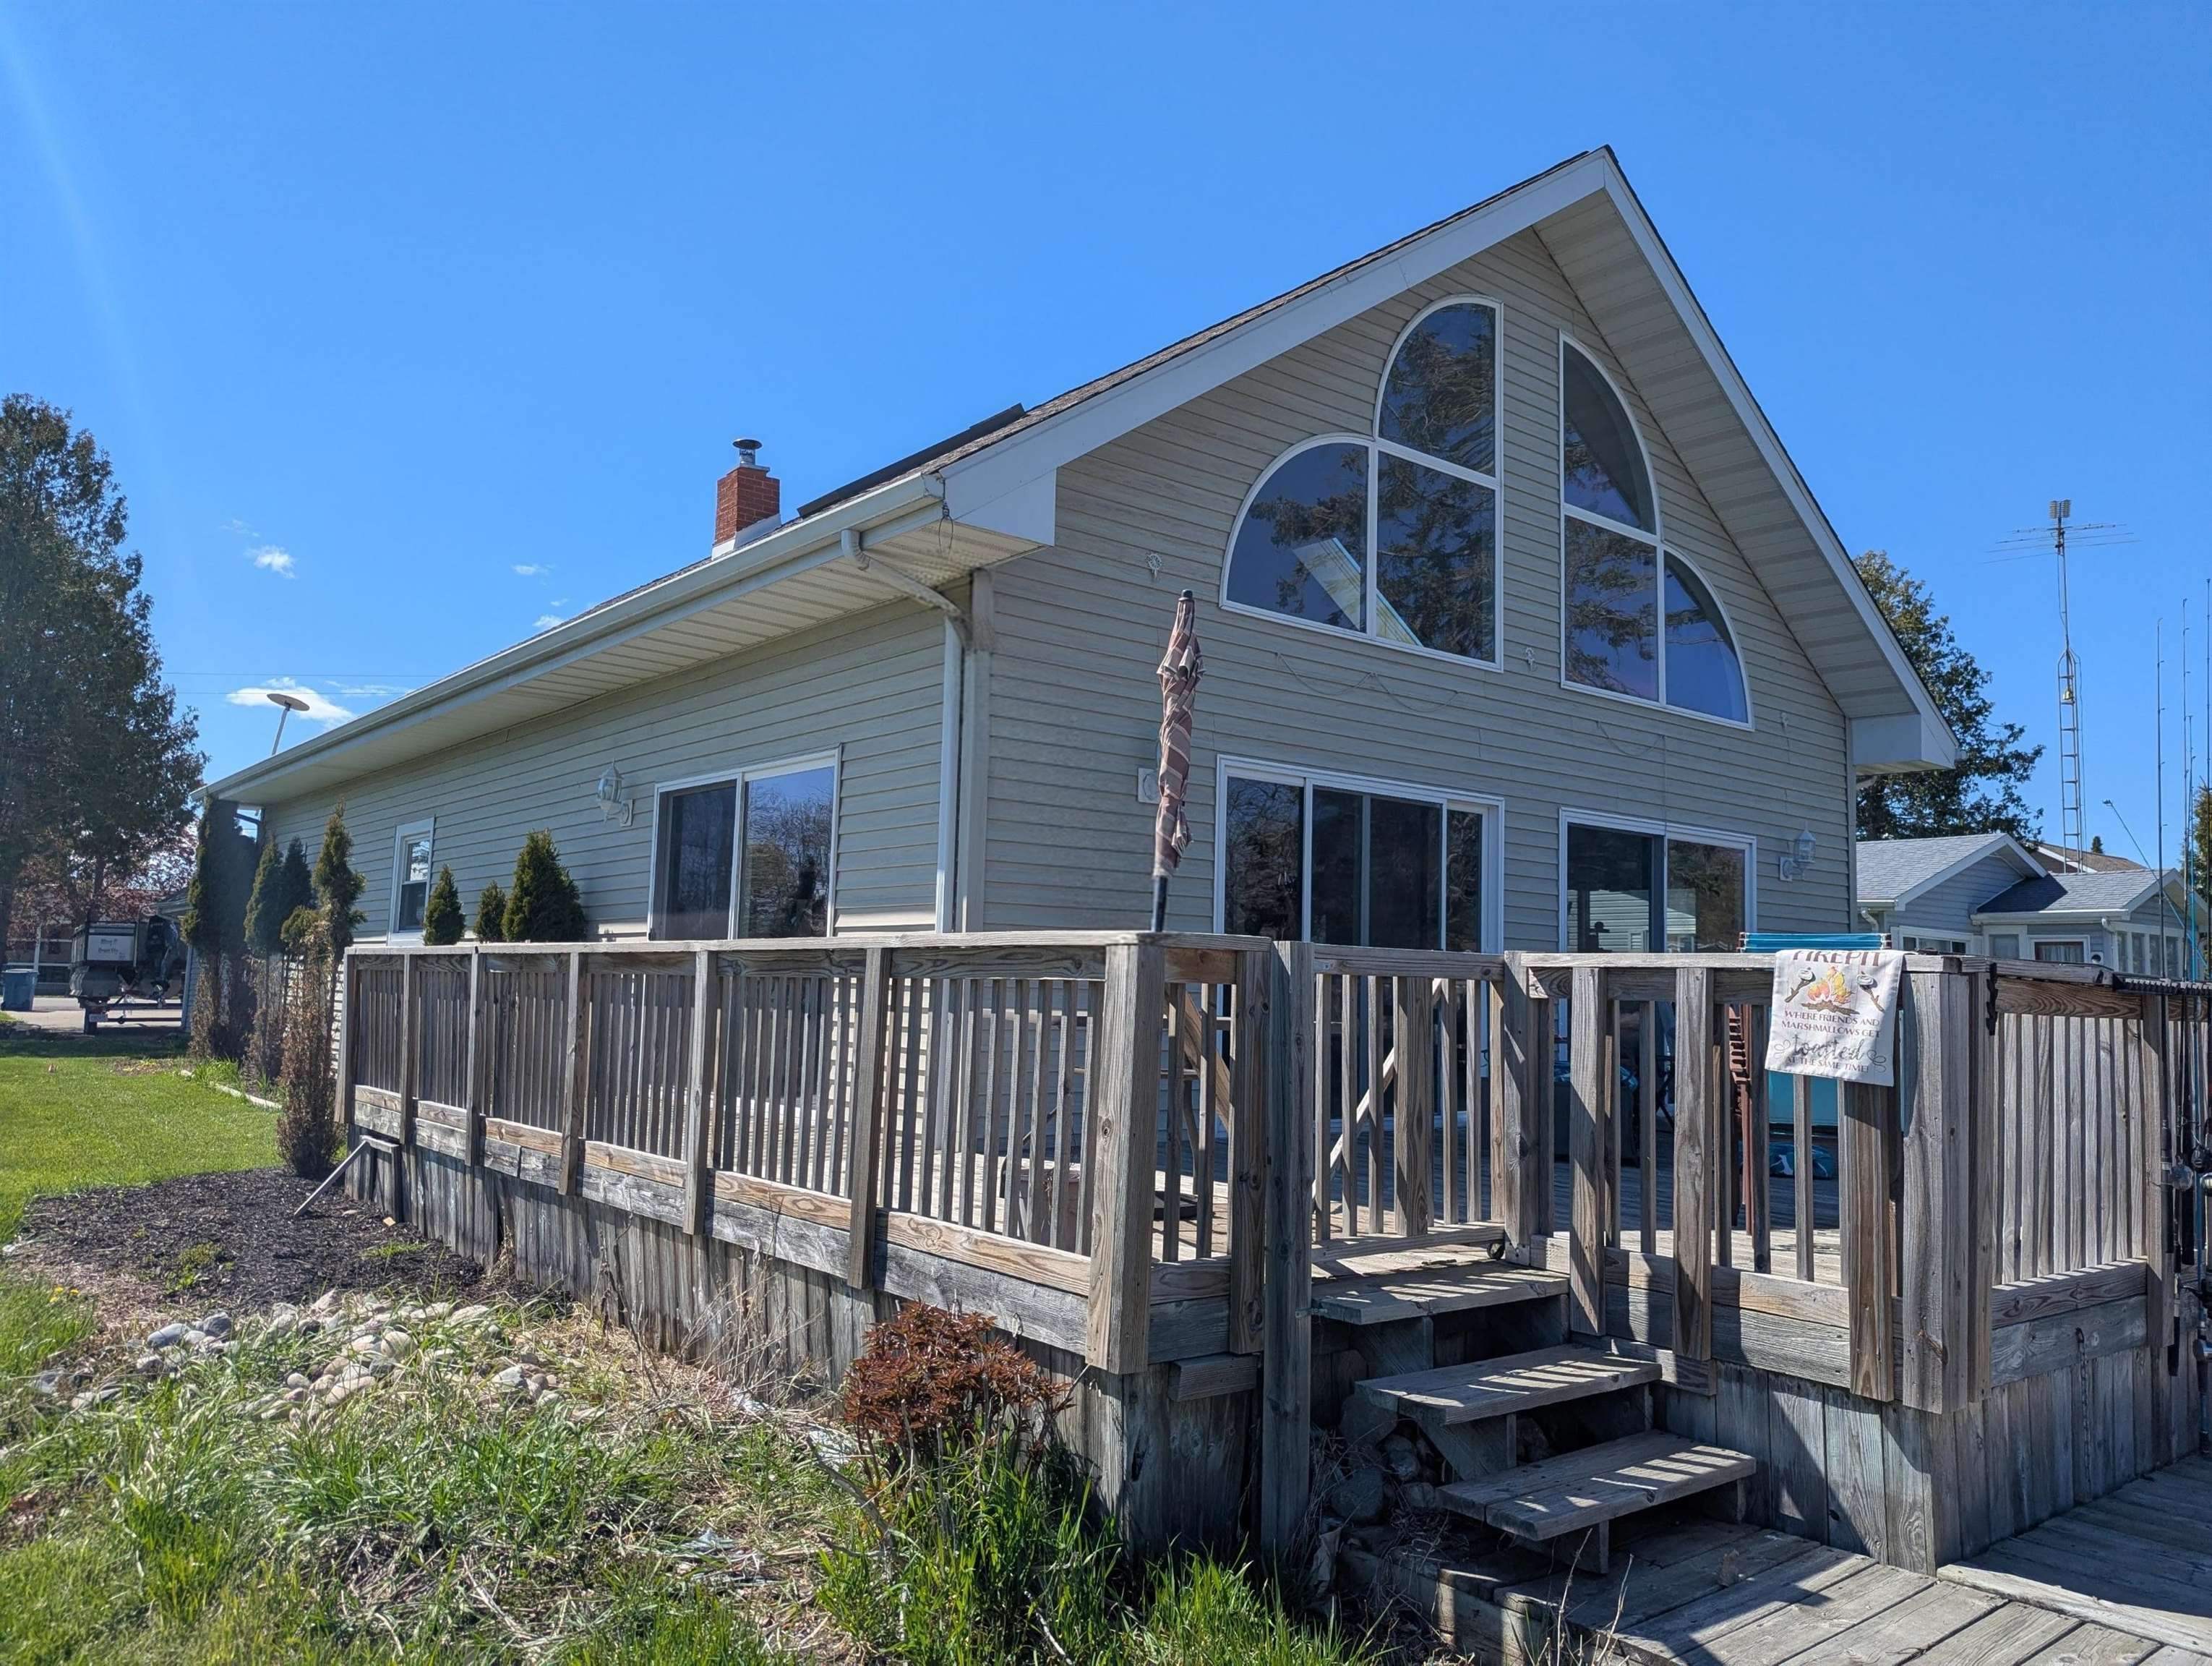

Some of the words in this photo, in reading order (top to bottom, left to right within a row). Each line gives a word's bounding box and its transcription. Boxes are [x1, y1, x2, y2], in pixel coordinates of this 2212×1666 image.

[1784, 1010, 1818, 1021] WHERE
[1819, 1014, 1858, 1025] FRIENDS
[1782, 1020, 1859, 1036] MARSHMALLOWS
[1862, 1029, 1881, 1038] GET
[1791, 1034, 1864, 1061] toasted
[1787, 1056, 1798, 1065] AT
[1799, 1057, 1815, 1066] THE
[1817, 1059, 1843, 1069] SAME
